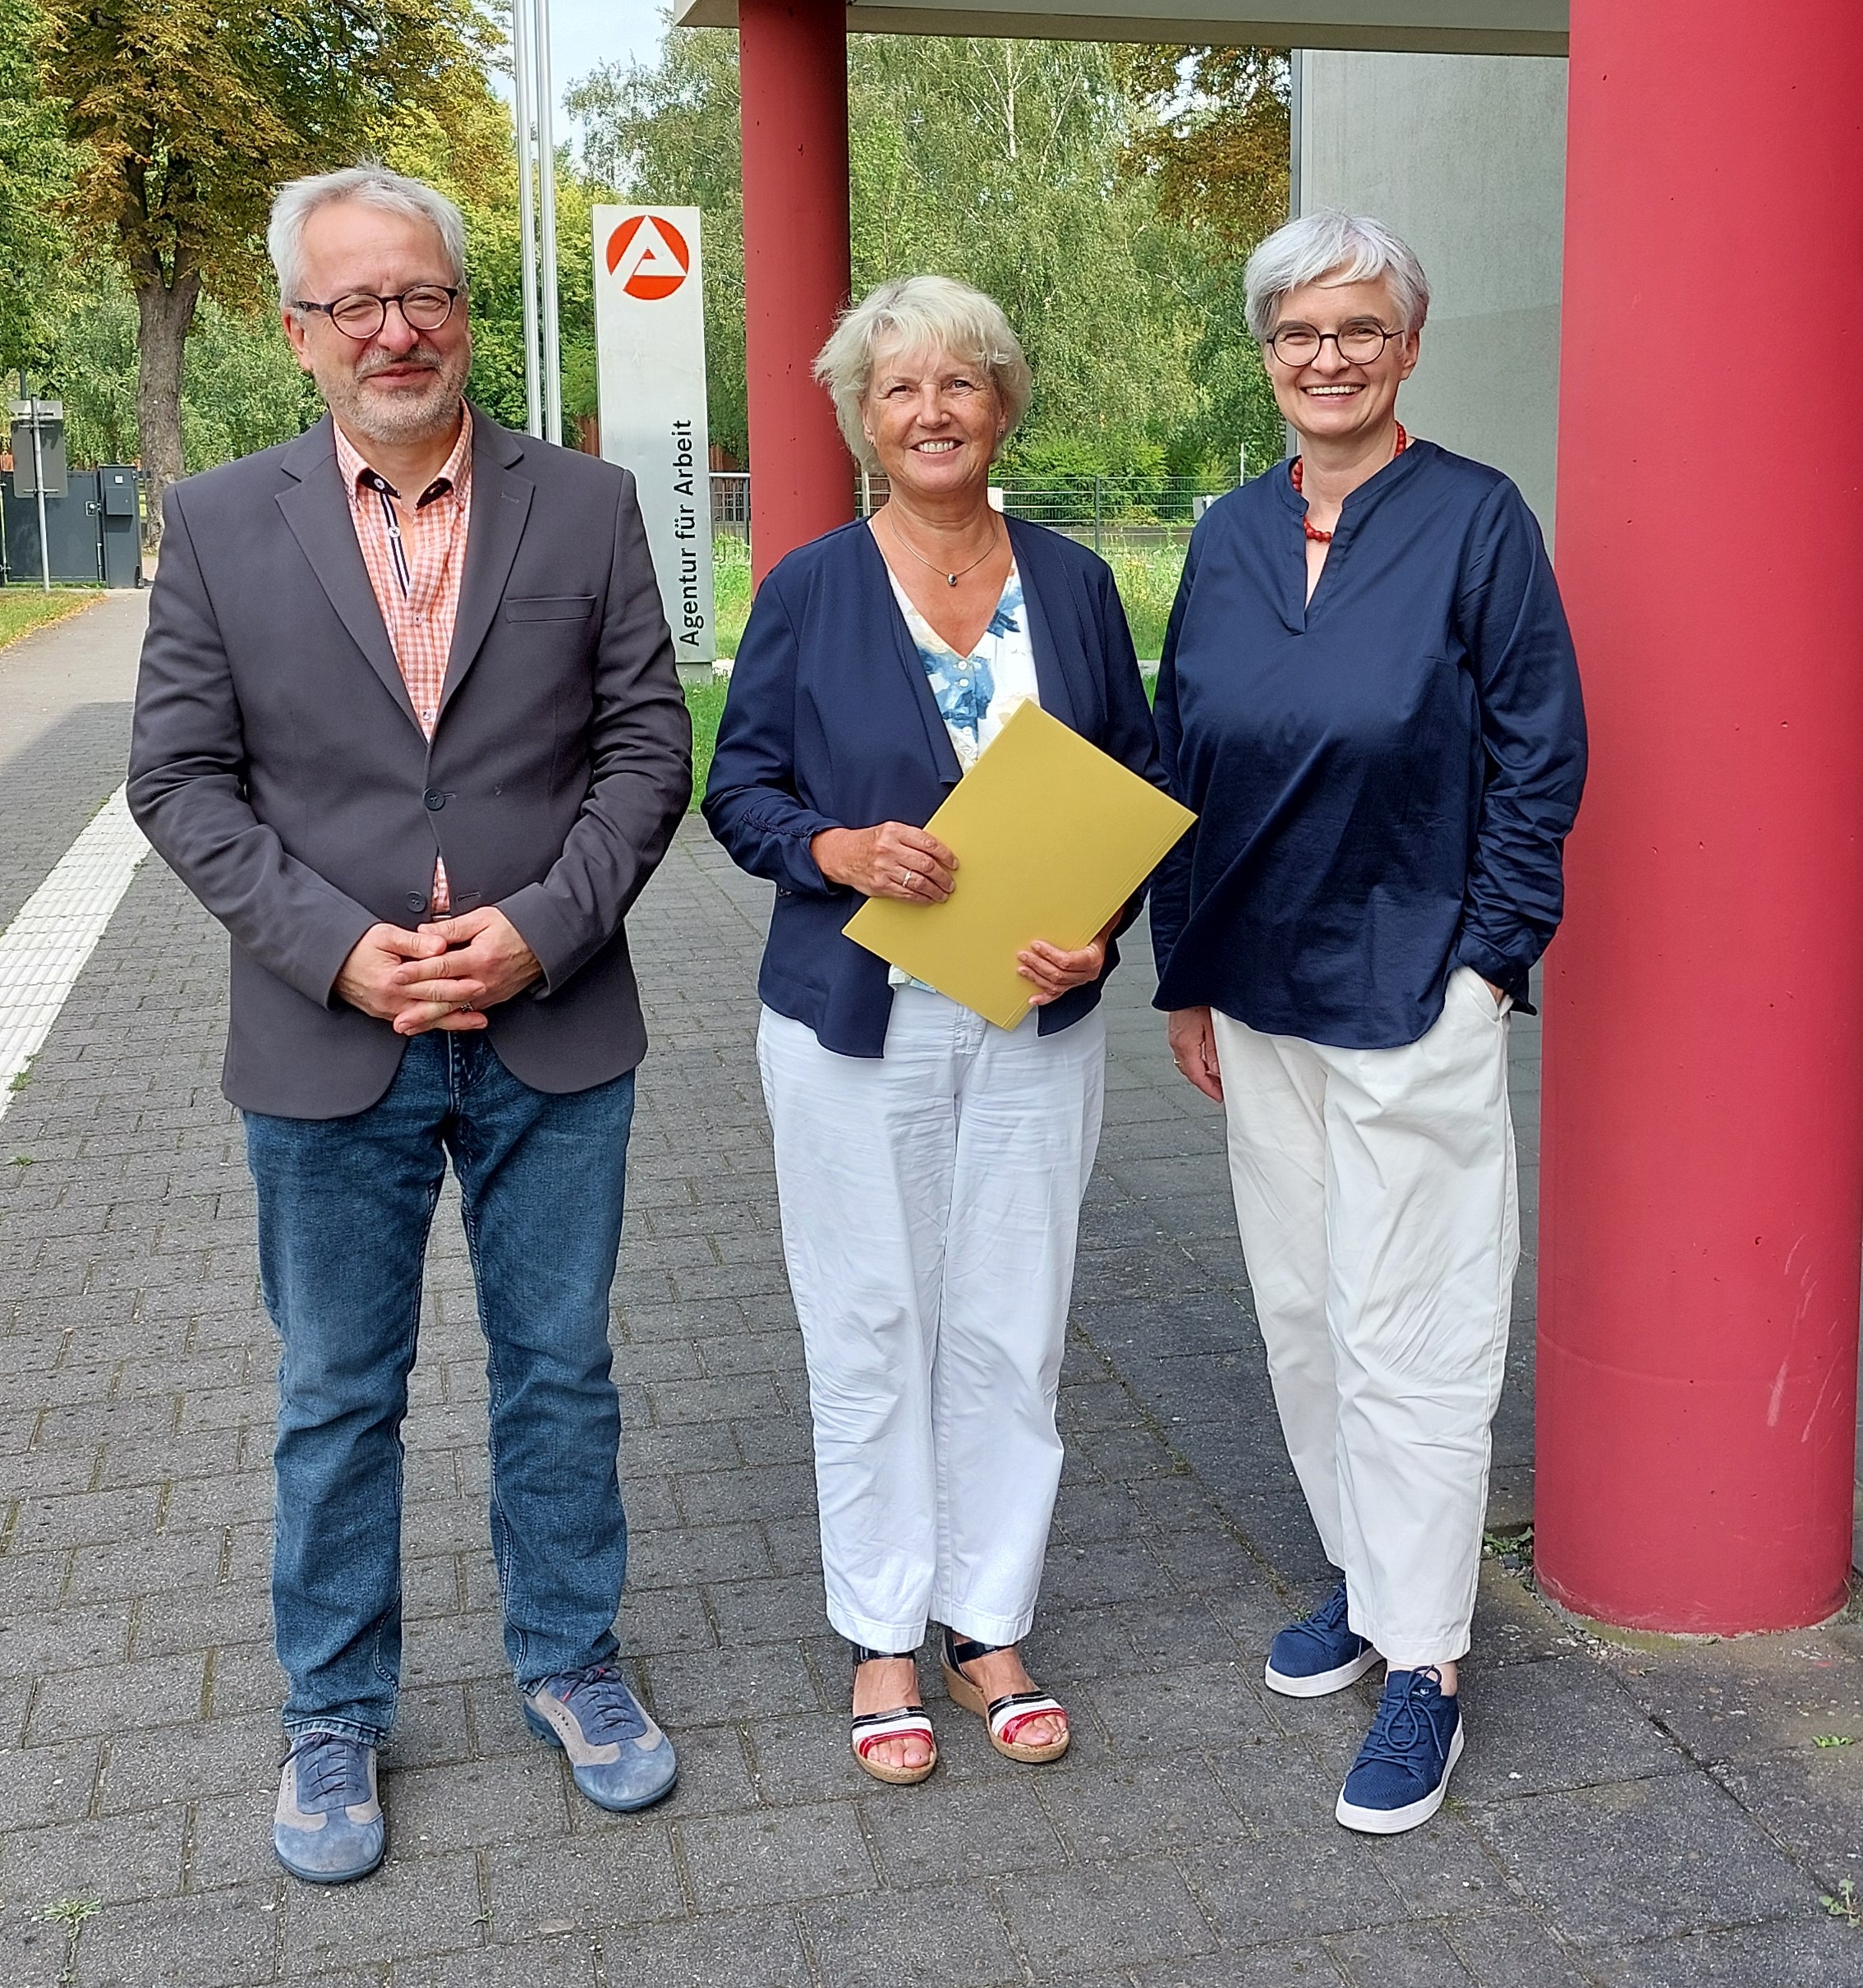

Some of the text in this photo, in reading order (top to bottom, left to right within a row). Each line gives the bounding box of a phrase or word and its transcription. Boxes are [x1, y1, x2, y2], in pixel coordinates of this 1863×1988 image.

[671, 419, 705, 647] Agentur für Arbeit
